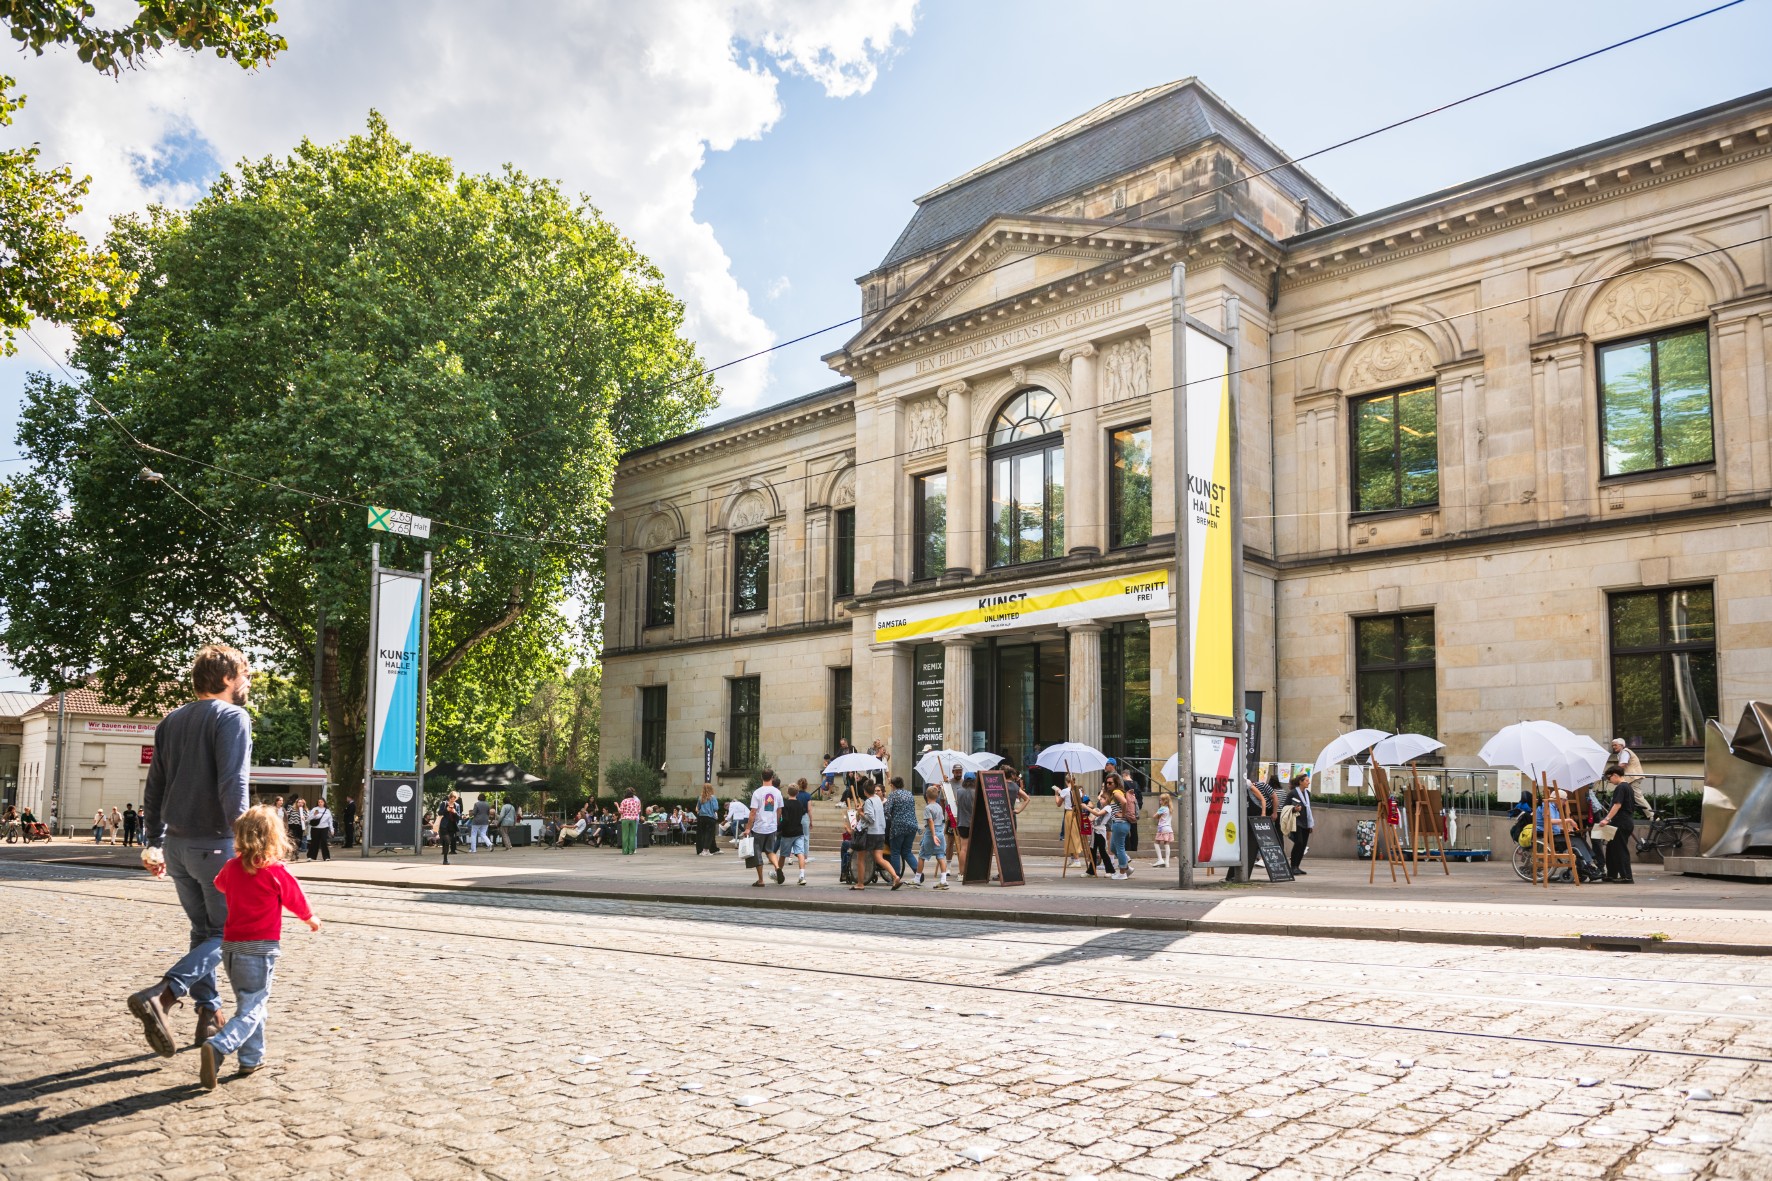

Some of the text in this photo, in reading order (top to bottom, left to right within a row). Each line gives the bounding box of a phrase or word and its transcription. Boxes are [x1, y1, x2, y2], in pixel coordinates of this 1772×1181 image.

[915, 297, 1124, 374] DEN BILDENDEN KUENSTEN GEWEIHT
[1187, 473, 1226, 503] KUNST
[1193, 498, 1221, 518] HALLE
[413, 523, 428, 532] Halt
[1196, 515, 1218, 529] BREMEN
[1125, 581, 1166, 595] EINTRITT
[979, 592, 1028, 613] KUNST
[1137, 593, 1153, 601] FREI
[984, 612, 1020, 623] UNLIMITED
[877, 618, 907, 629] SAMSTAG
[380, 649, 417, 662] KUNST
[385, 660, 411, 670] HALLE
[922, 662, 943, 671] REMIX
[921, 698, 943, 708] KUNST
[917, 733, 943, 741] SPRINGE
[1199, 776, 1235, 794] KUNST
[1204, 796, 1230, 804] UNLIMITED
[381, 806, 408, 814] KUNST
